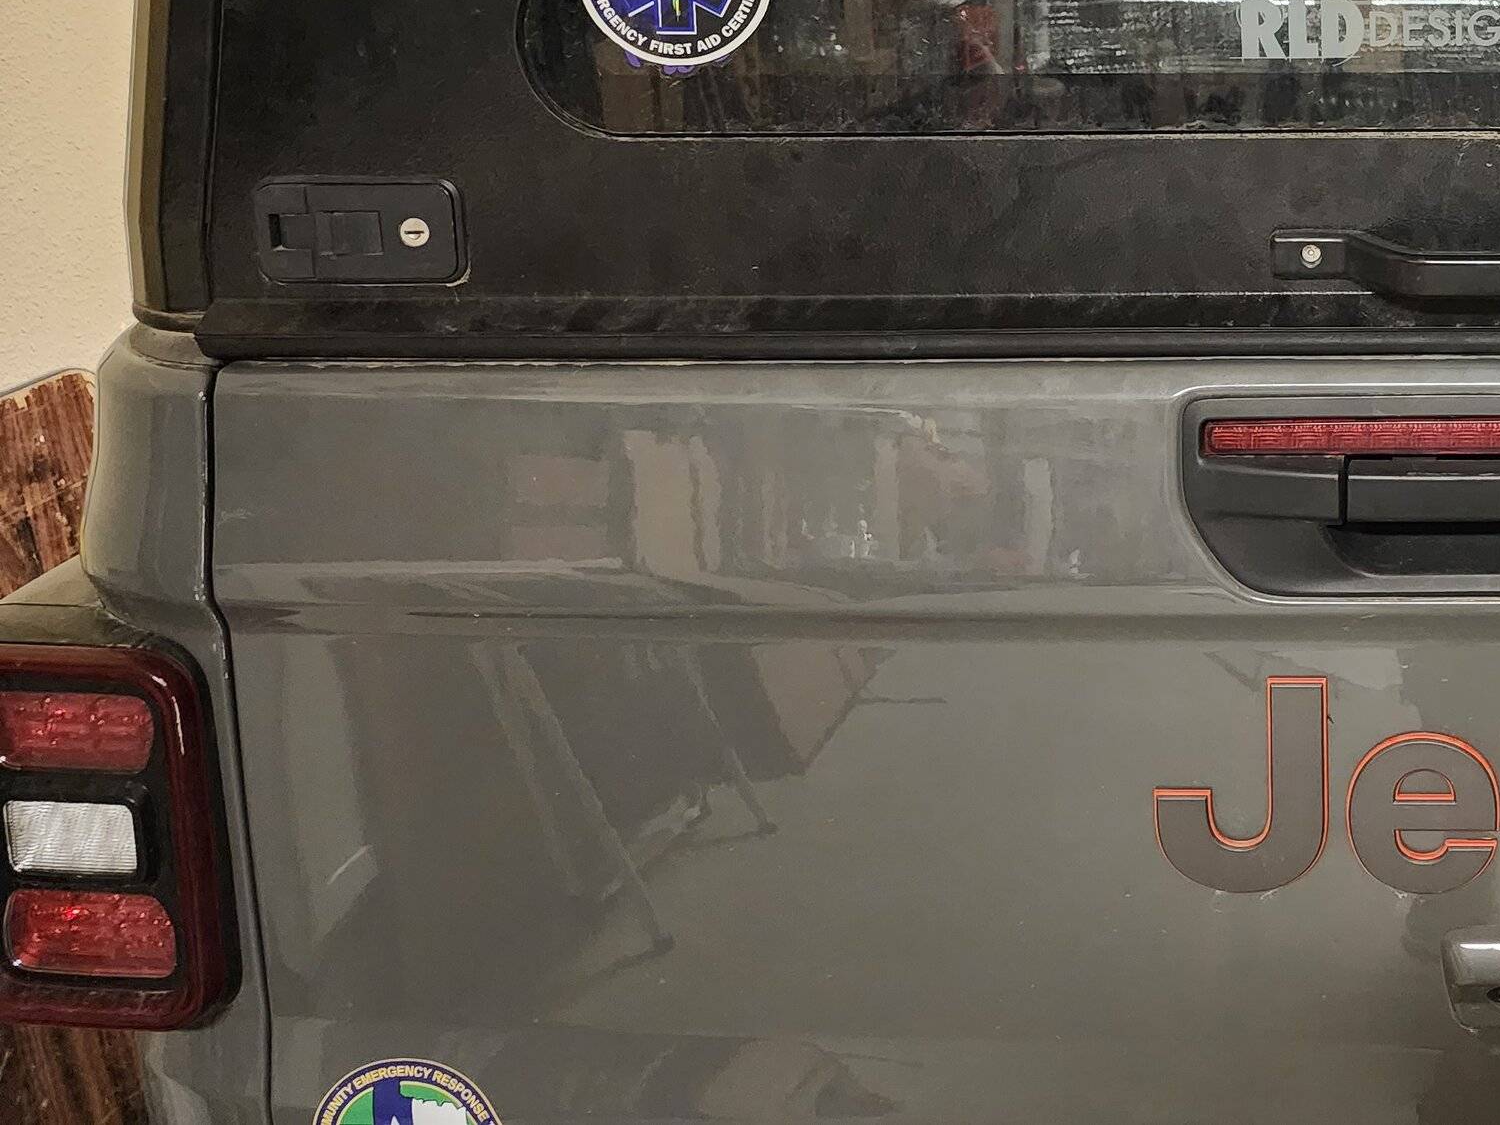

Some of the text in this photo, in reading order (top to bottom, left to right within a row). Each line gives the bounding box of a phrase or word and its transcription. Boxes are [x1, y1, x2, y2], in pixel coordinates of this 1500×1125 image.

[649, 39, 693, 56] FIRST
[697, 34, 722, 53] AID
[352, 1064, 434, 1090] EMERGENCY
[431, 1069, 491, 1123] RESPONSE
